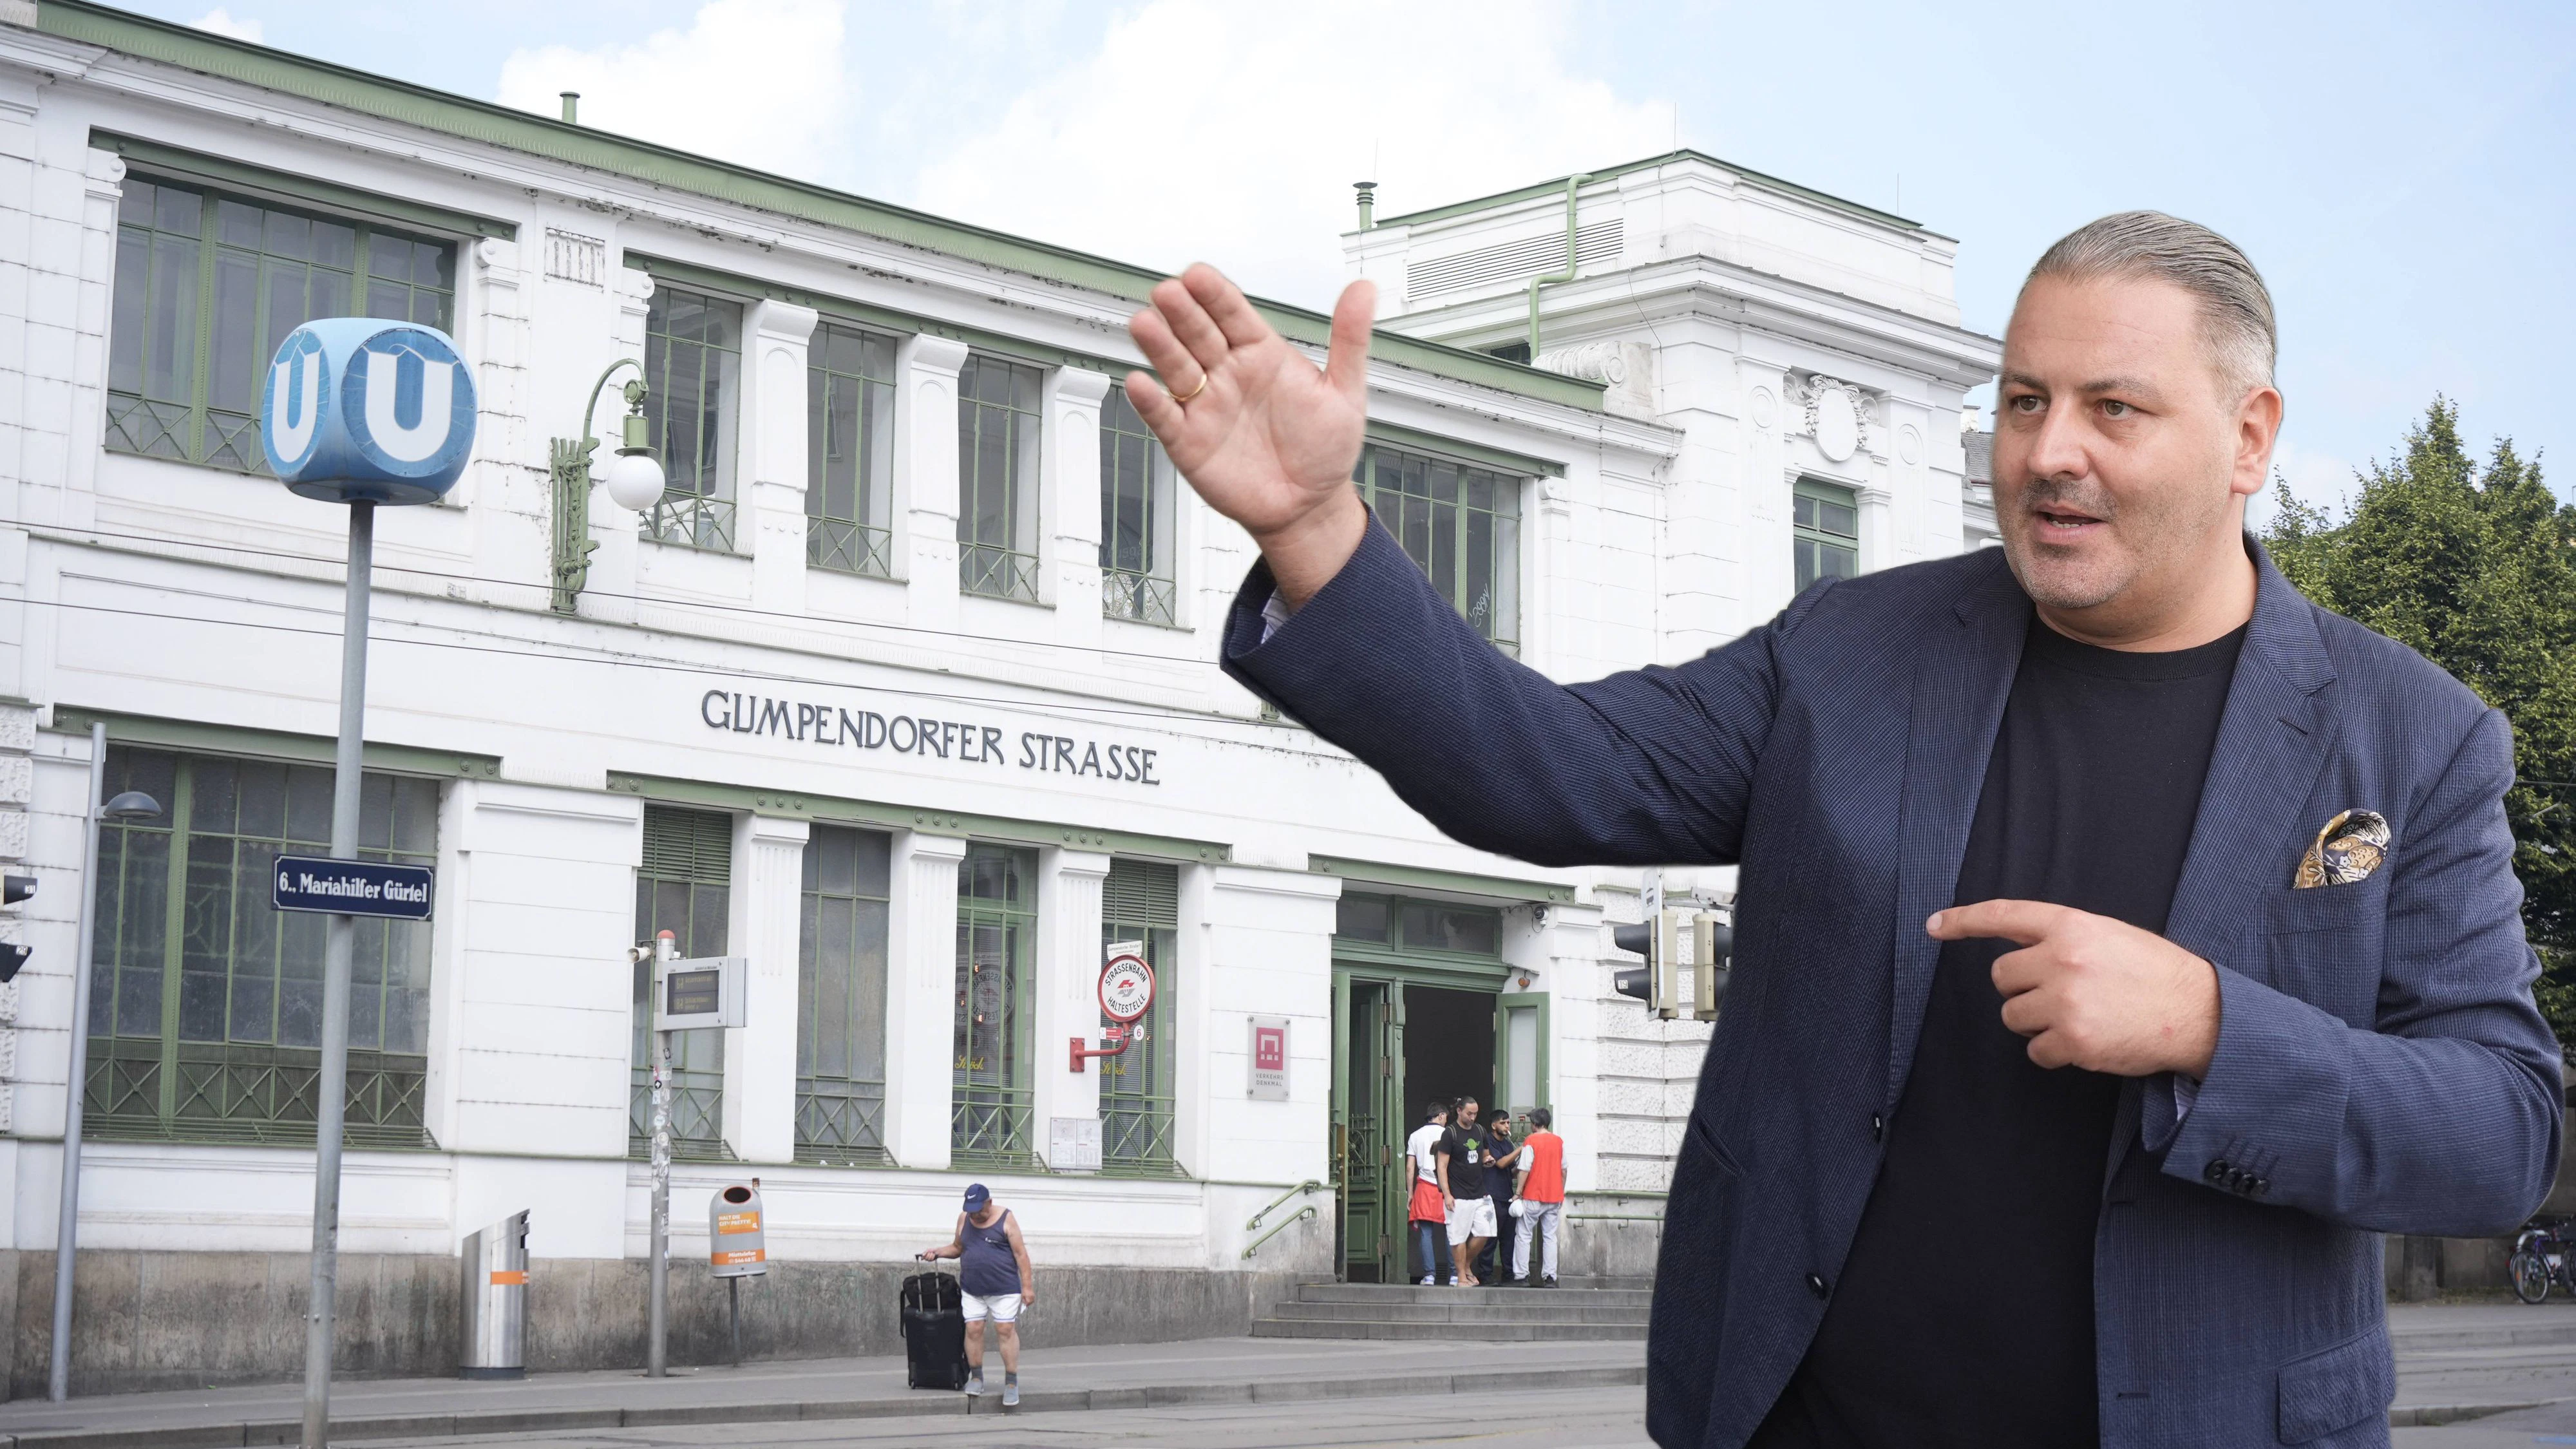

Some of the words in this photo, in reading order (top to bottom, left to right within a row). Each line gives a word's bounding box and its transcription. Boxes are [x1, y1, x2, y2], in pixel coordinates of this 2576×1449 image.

[273, 352, 321, 463] U
[365, 351, 453, 462] U
[701, 690, 1005, 764] GUMPENDORFER
[1019, 732, 1160, 785] STRASSE
[299, 873, 381, 899] Mariahilfer
[384, 880, 428, 903] Gürtel
[1105, 963, 1148, 987] STRASSENBAHN
[1107, 993, 1146, 1014] HALTESTELLE
[1137, 1028, 1141, 1037] 6
